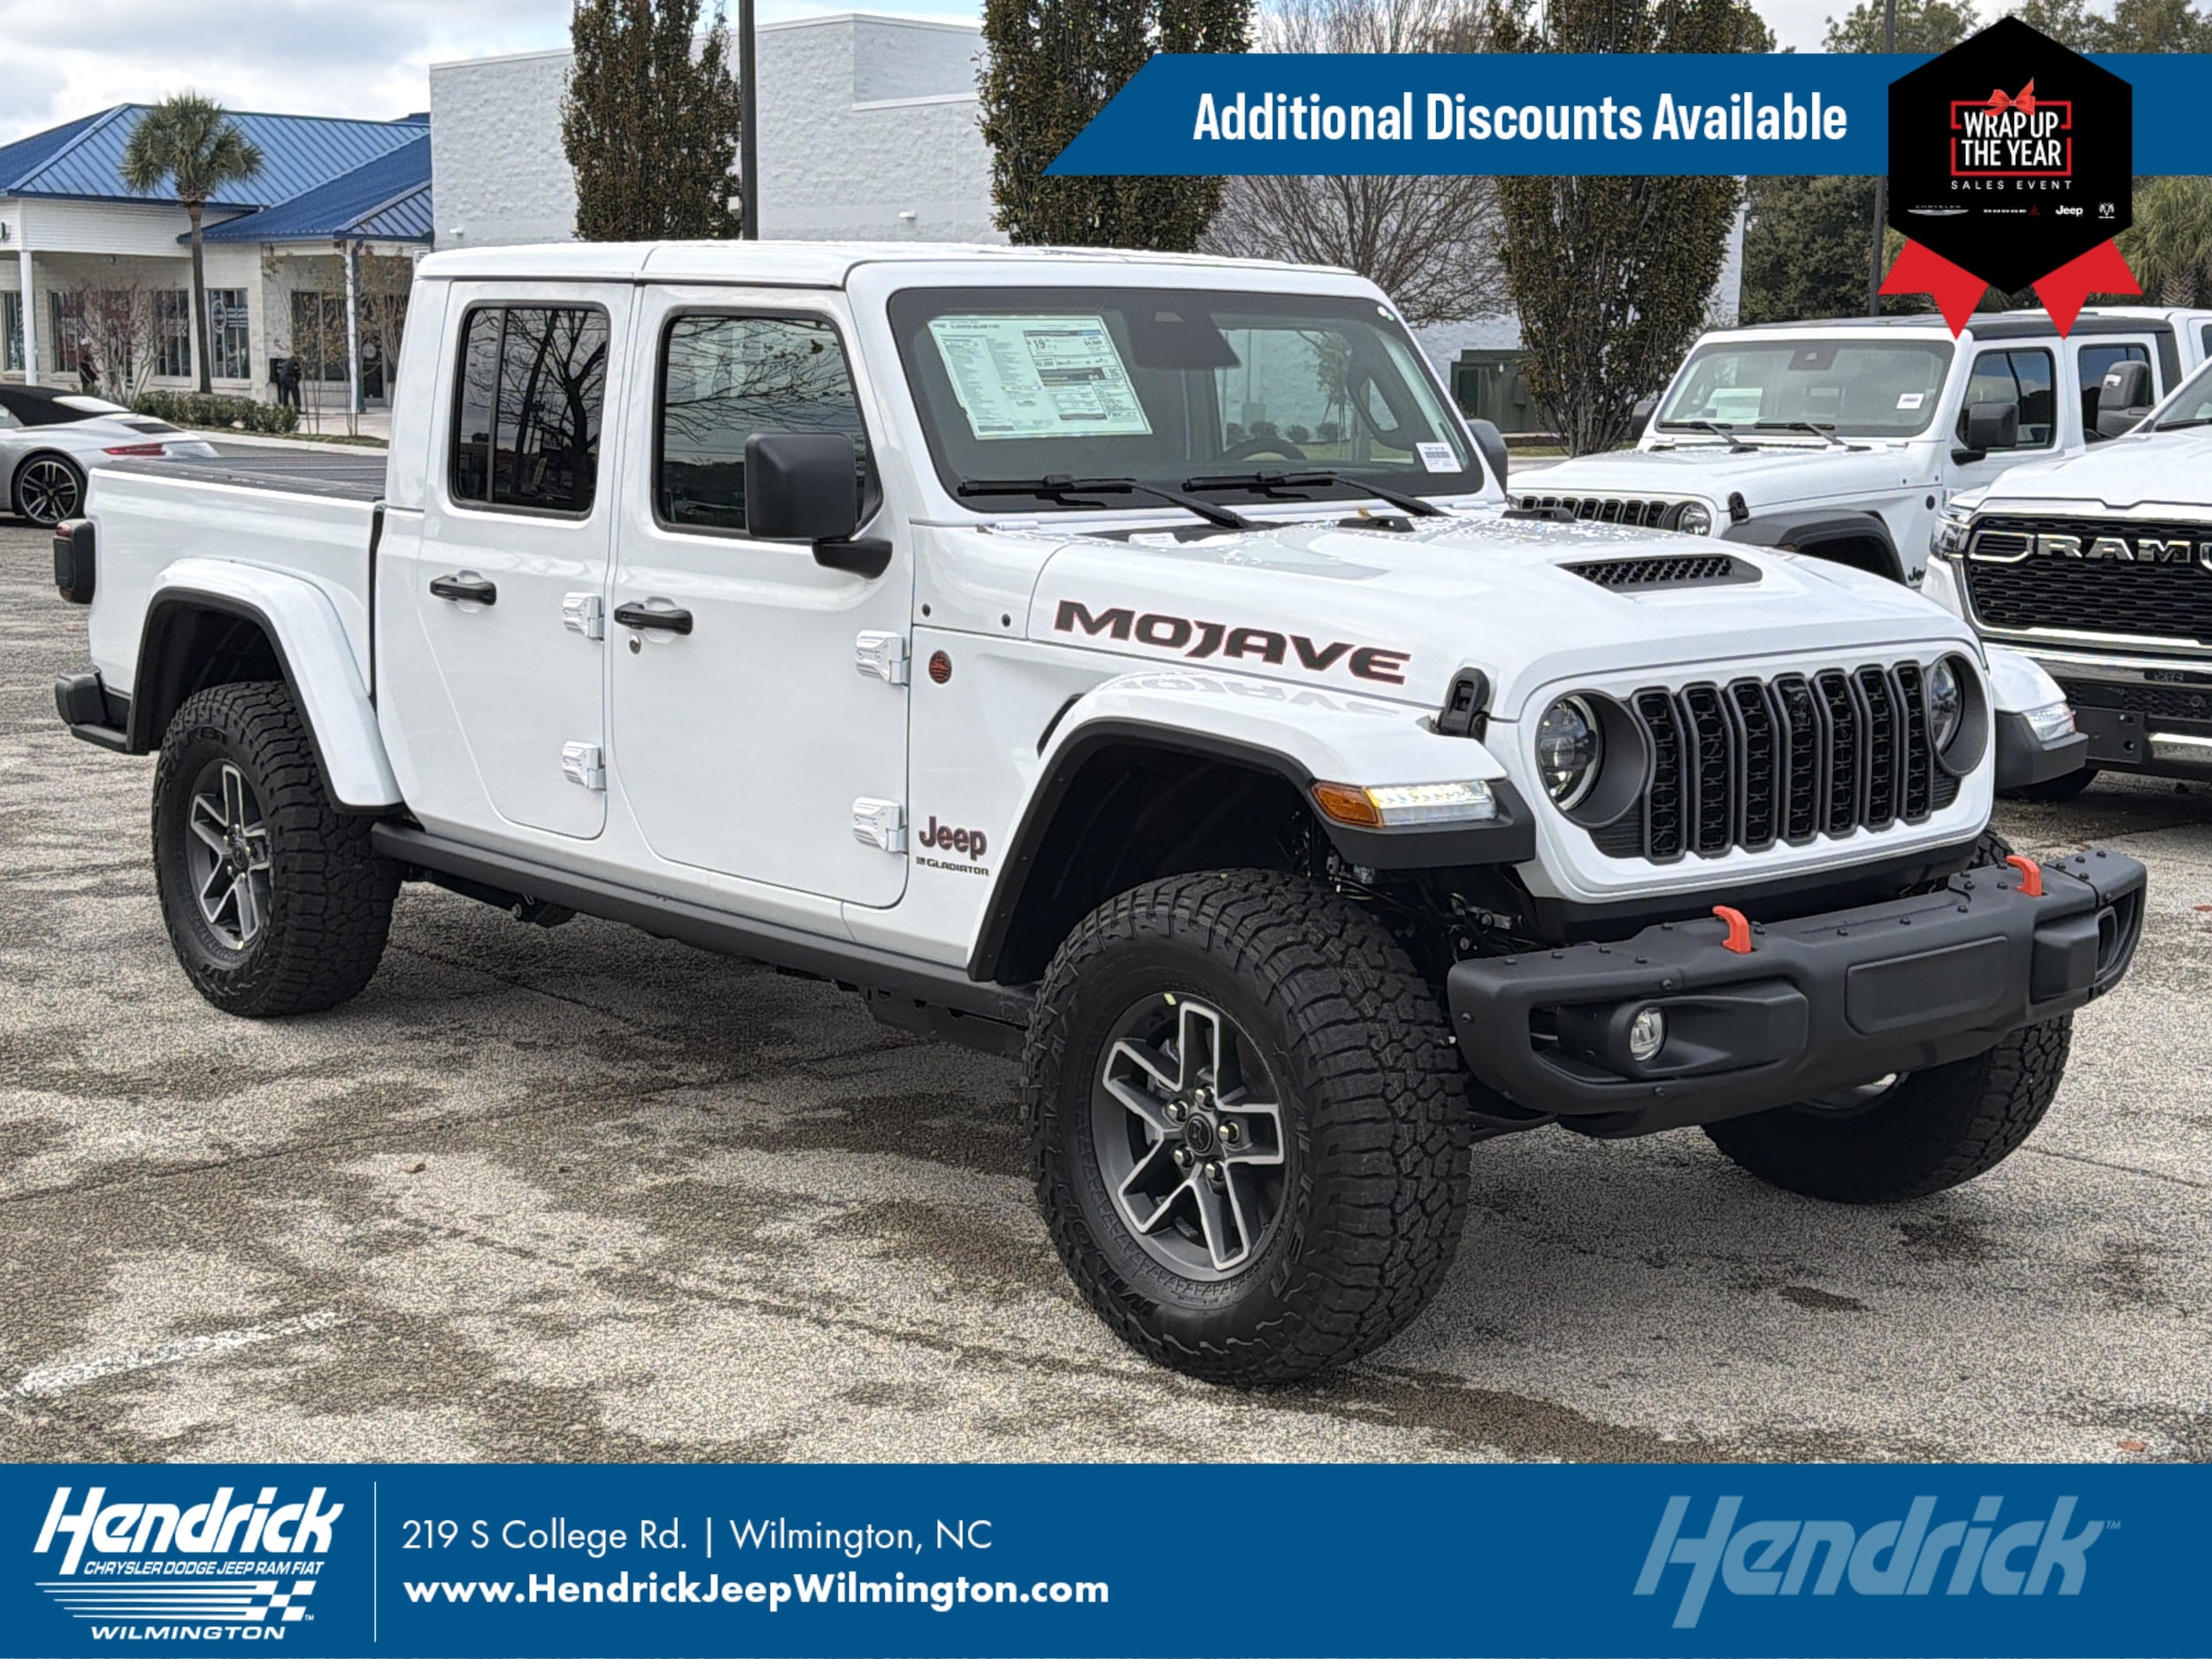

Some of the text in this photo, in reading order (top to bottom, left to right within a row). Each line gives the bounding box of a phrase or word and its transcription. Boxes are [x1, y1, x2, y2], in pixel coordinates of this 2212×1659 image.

[2037, 534, 2192, 563] RAM
[1054, 599, 1412, 686] MOJAVE
[918, 815, 988, 862] Jeep
[926, 857, 990, 877] GLADIATOR
